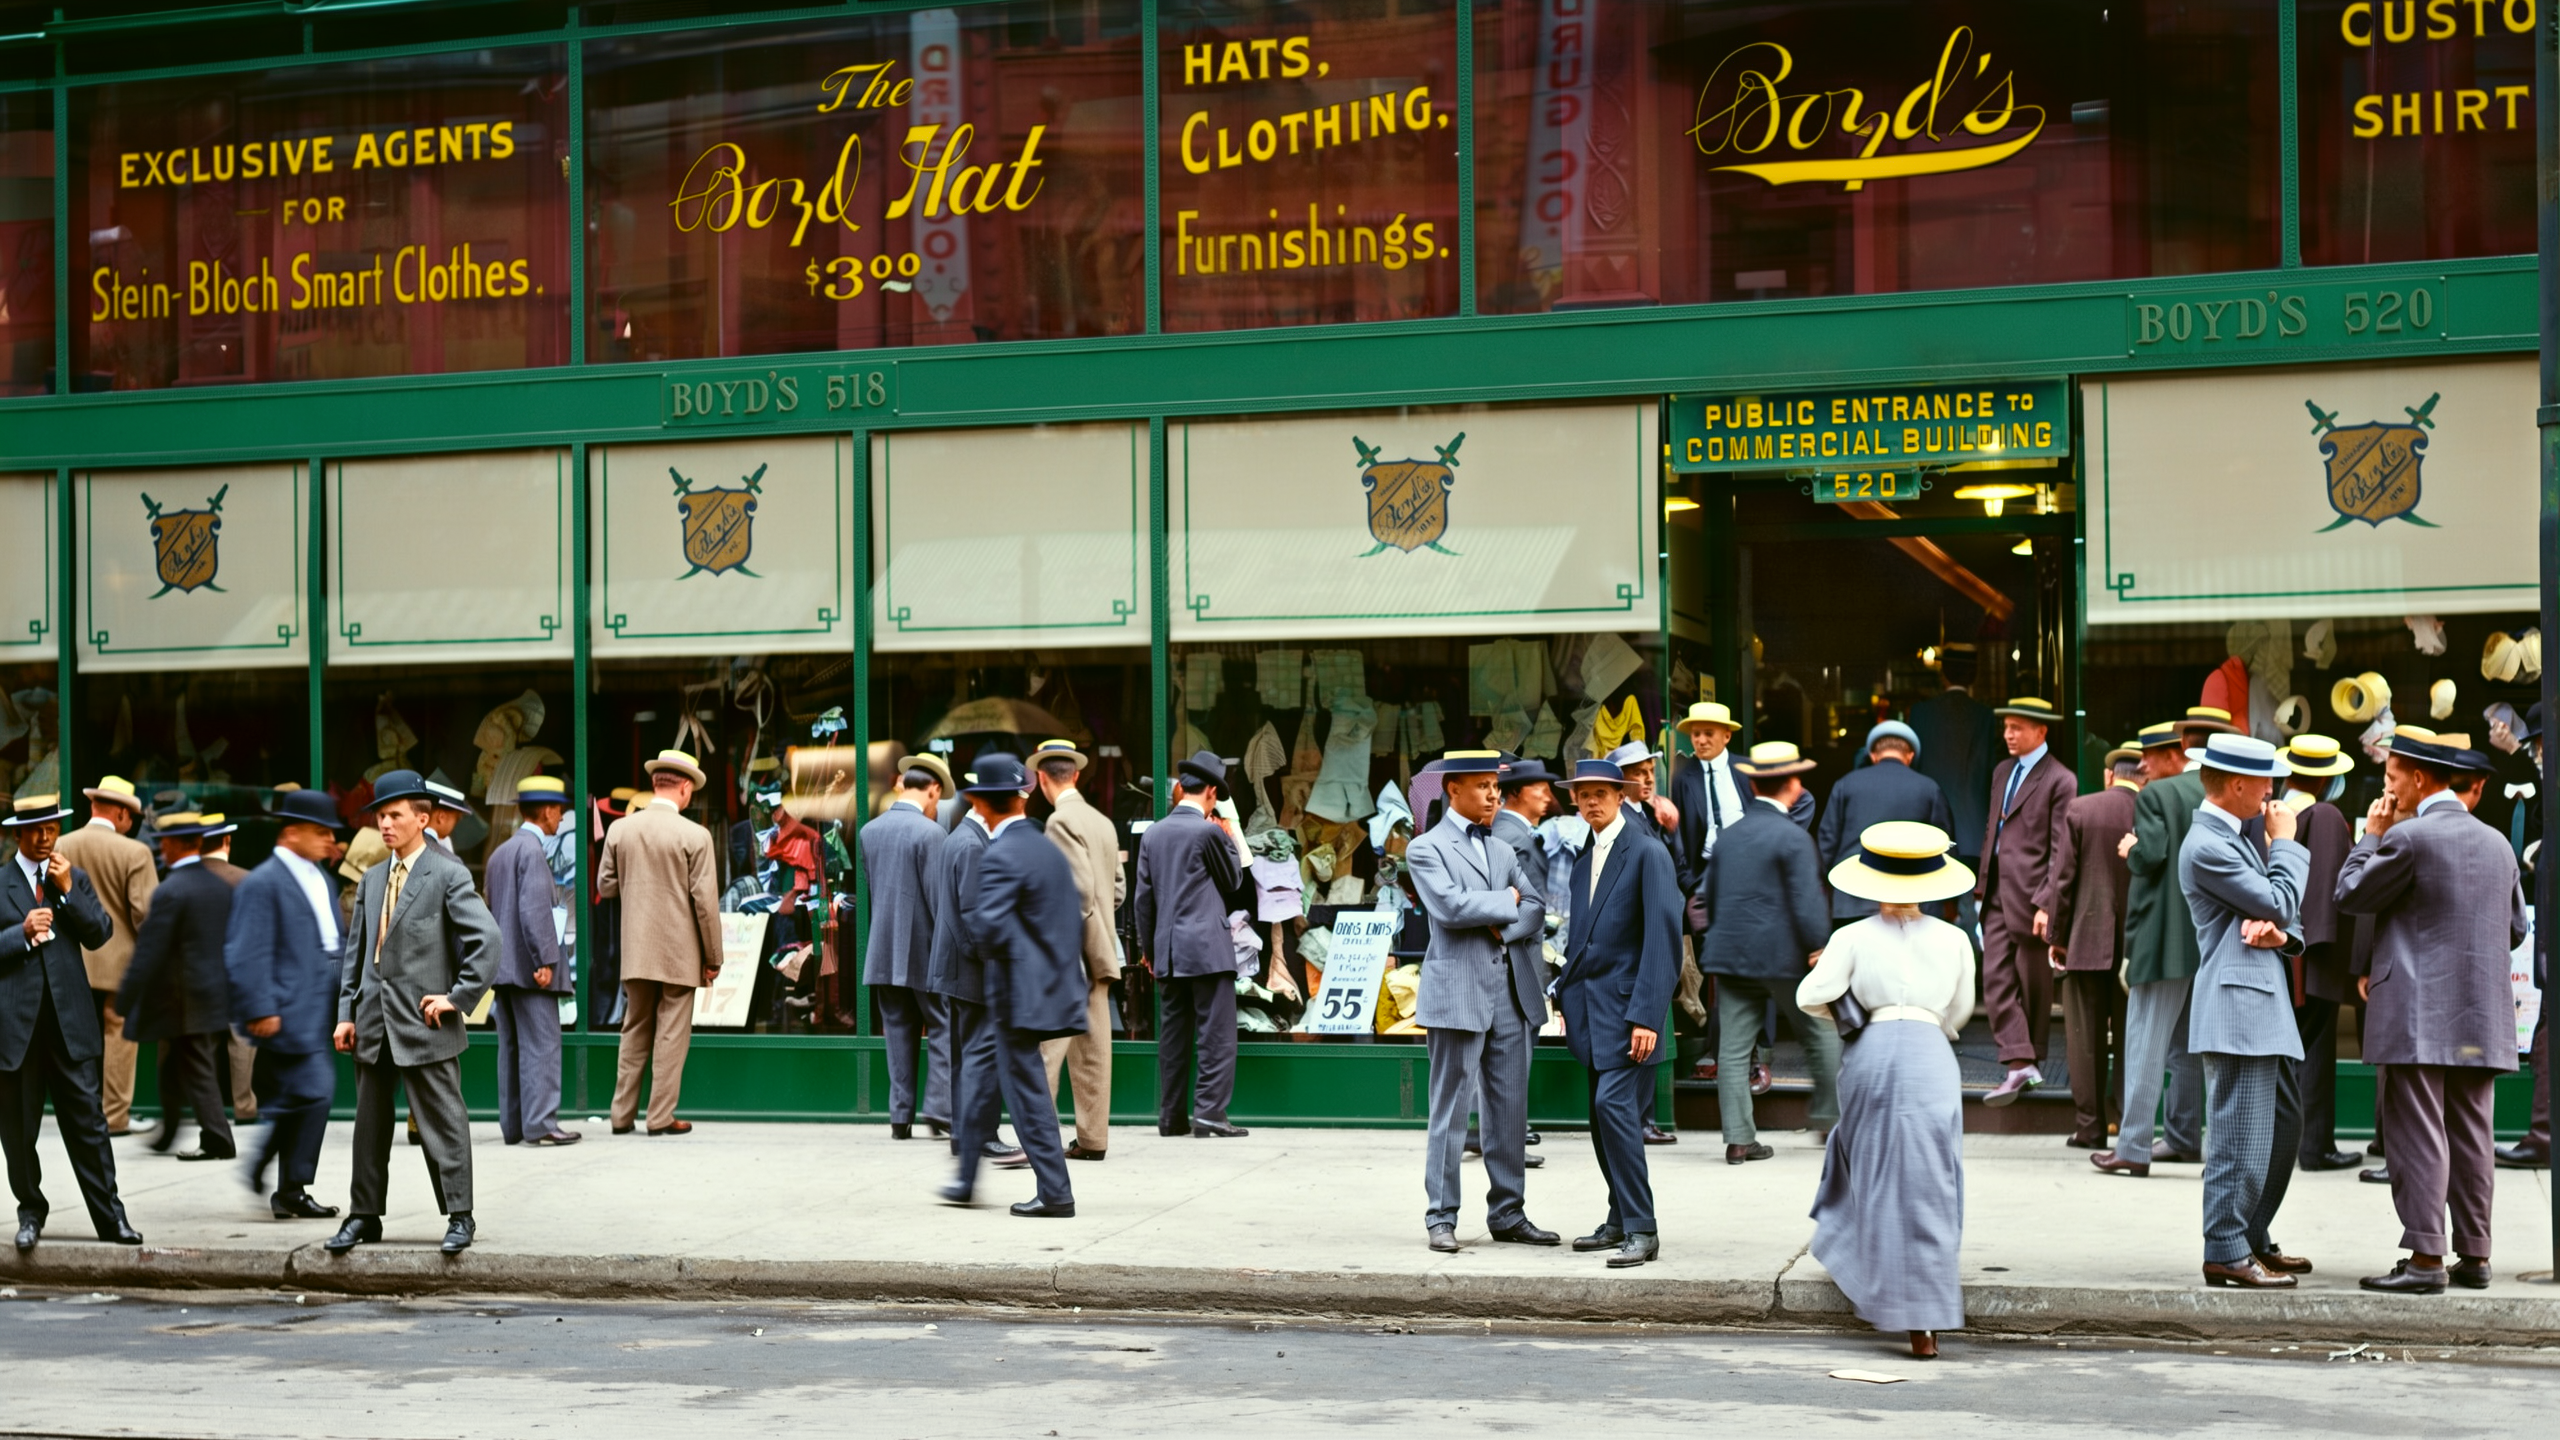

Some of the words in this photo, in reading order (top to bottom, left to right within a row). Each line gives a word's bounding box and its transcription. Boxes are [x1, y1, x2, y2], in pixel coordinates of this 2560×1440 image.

[816, 59, 915, 113] The
[1184, 36, 1330, 85] HATS,
[1685, 26, 2046, 192] Boyd's
[2353, 85, 2529, 138] SHIRT
[120, 136, 334, 189] EXCLUSIVE
[352, 121, 515, 170] AGENTS
[283, 196, 346, 226] FOR
[668, 133, 861, 247] Boyd
[885, 123, 1047, 220] Hat
[1177, 203, 1450, 276] Furnishings.
[92, 256, 279, 322] Stein-Bloch
[291, 252, 384, 310] Smart
[393, 242, 544, 304] Clothes.
[2136, 290, 2308, 345] BOYD'S
[2344, 288, 2433, 335] 520
[671, 371, 799, 417] BOYD'S
[827, 371, 886, 411] 518
[1706, 400, 1815, 430] PUBLIC
[1832, 392, 1995, 424] ENTRANCE
[2006, 393, 2034, 411] TO
[1687, 429, 1889, 463] COMMERCIAL
[1902, 421, 2052, 455] BUILDING
[1834, 472, 1897, 498] 520
[1321, 988, 1364, 1020] 55
